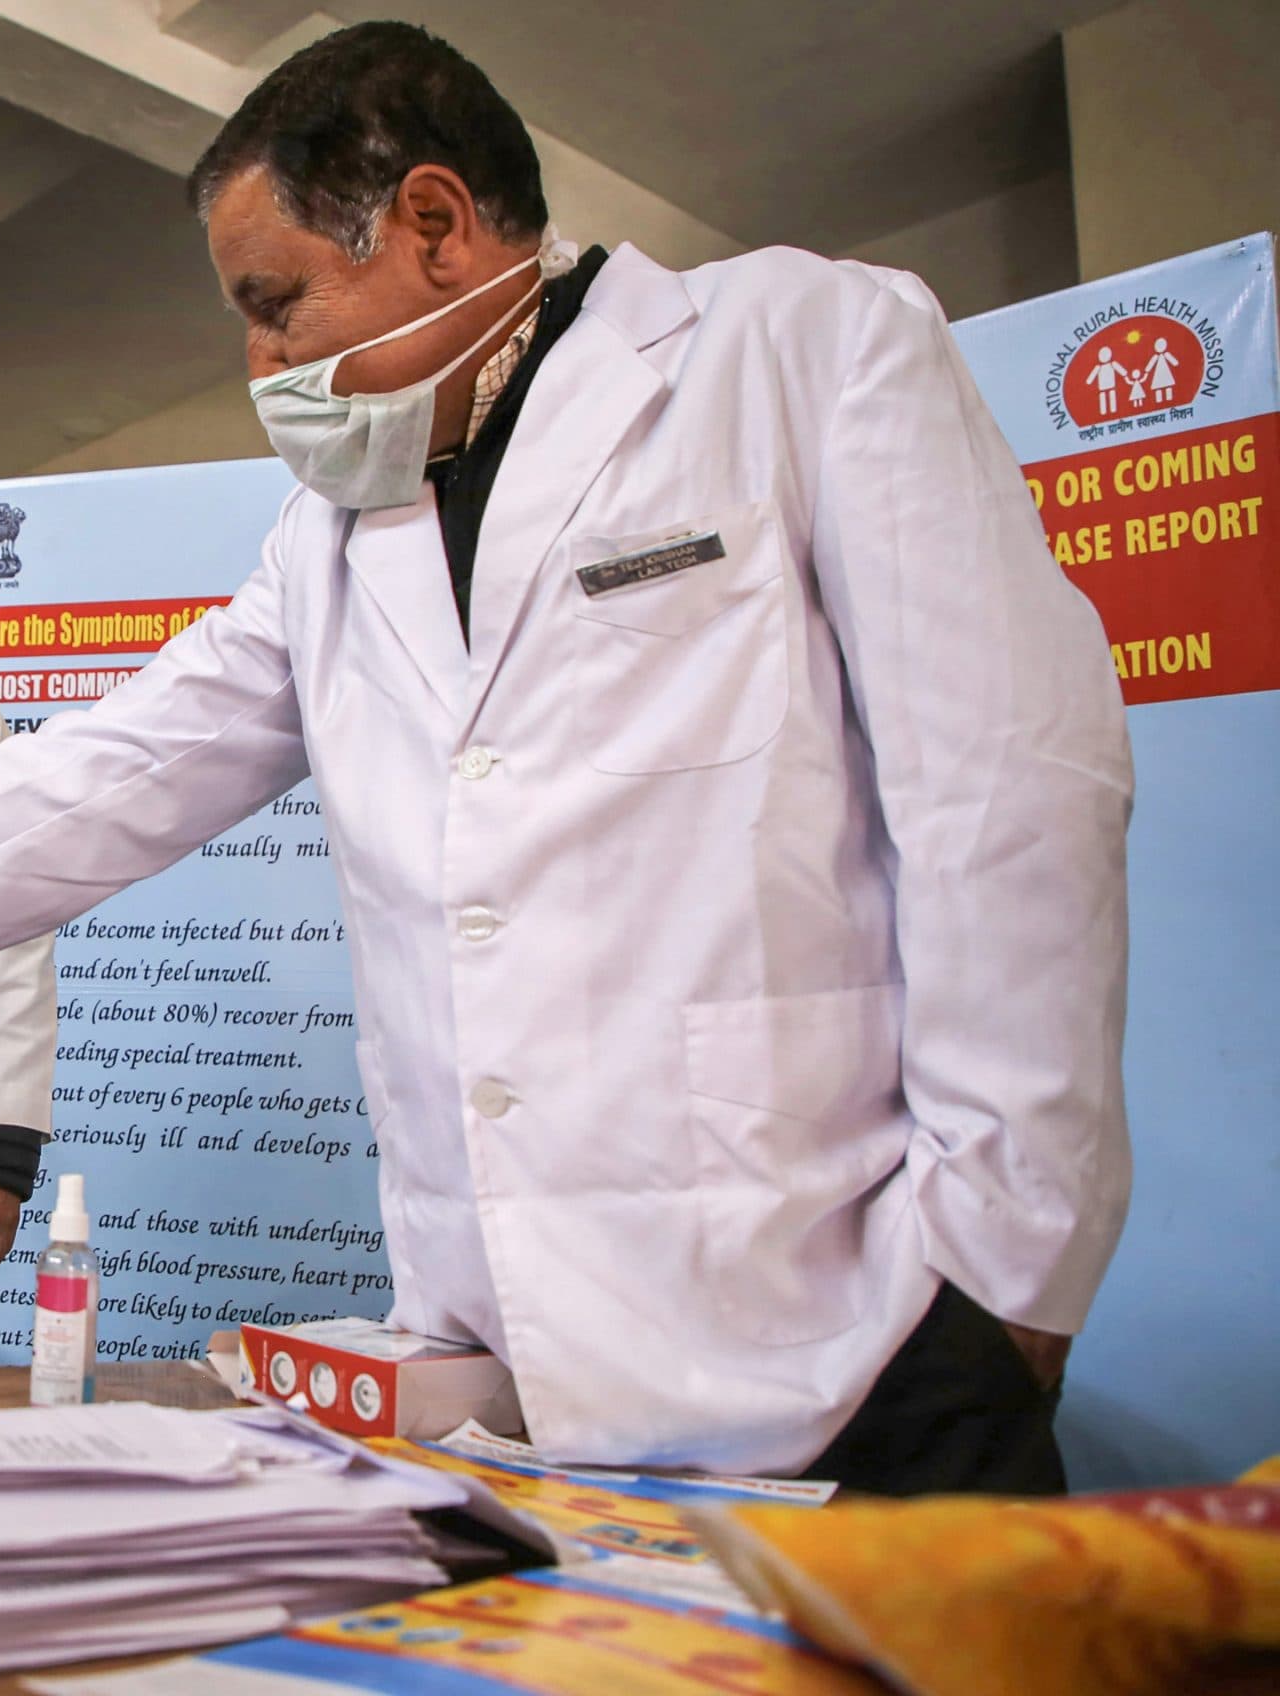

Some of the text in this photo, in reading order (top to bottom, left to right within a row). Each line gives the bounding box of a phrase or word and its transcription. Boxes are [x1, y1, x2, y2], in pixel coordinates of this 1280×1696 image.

[1046, 296, 1224, 430] NATIONAL RURAL HEALTH MISSION
[1056, 467, 1102, 506] OR
[1113, 434, 1256, 497] COMING
[1045, 497, 1262, 567] ASE REPORT
[24, 614, 55, 645] the
[60, 611, 166, 648] Symptoms
[169, 606, 191, 639] of
[48, 671, 135, 699] COMMO
[201, 835, 282, 864] usually
[86, 917, 344, 946] become infected but don't
[61, 958, 270, 987] and don't feel unwell.
[92, 1000, 354, 1033] (about 80%) recover from
[122, 1043, 194, 1069] special
[196, 1049, 301, 1068] treatment.
[51, 1085, 86, 1103] out
[89, 1082, 114, 1109] of
[113, 1090, 166, 1112] every
[171, 1088, 184, 1106] 6
[186, 1087, 252, 1115] people
[259, 1089, 304, 1111] who
[304, 1096, 351, 1119] gets
[52, 1124, 147, 1153] seriously
[161, 1126, 187, 1148] ill
[198, 1129, 243, 1150] and
[254, 1131, 351, 1163] develops
[99, 1209, 384, 1252] and those with underlying
[137, 1251, 196, 1275] blood
[195, 1263, 285, 1285] pressure,
[292, 1262, 347, 1286] heart
[131, 1293, 187, 1324] likely
[192, 1303, 211, 1320] to
[216, 1300, 295, 1325] develop
[152, 1340, 200, 1360] with
